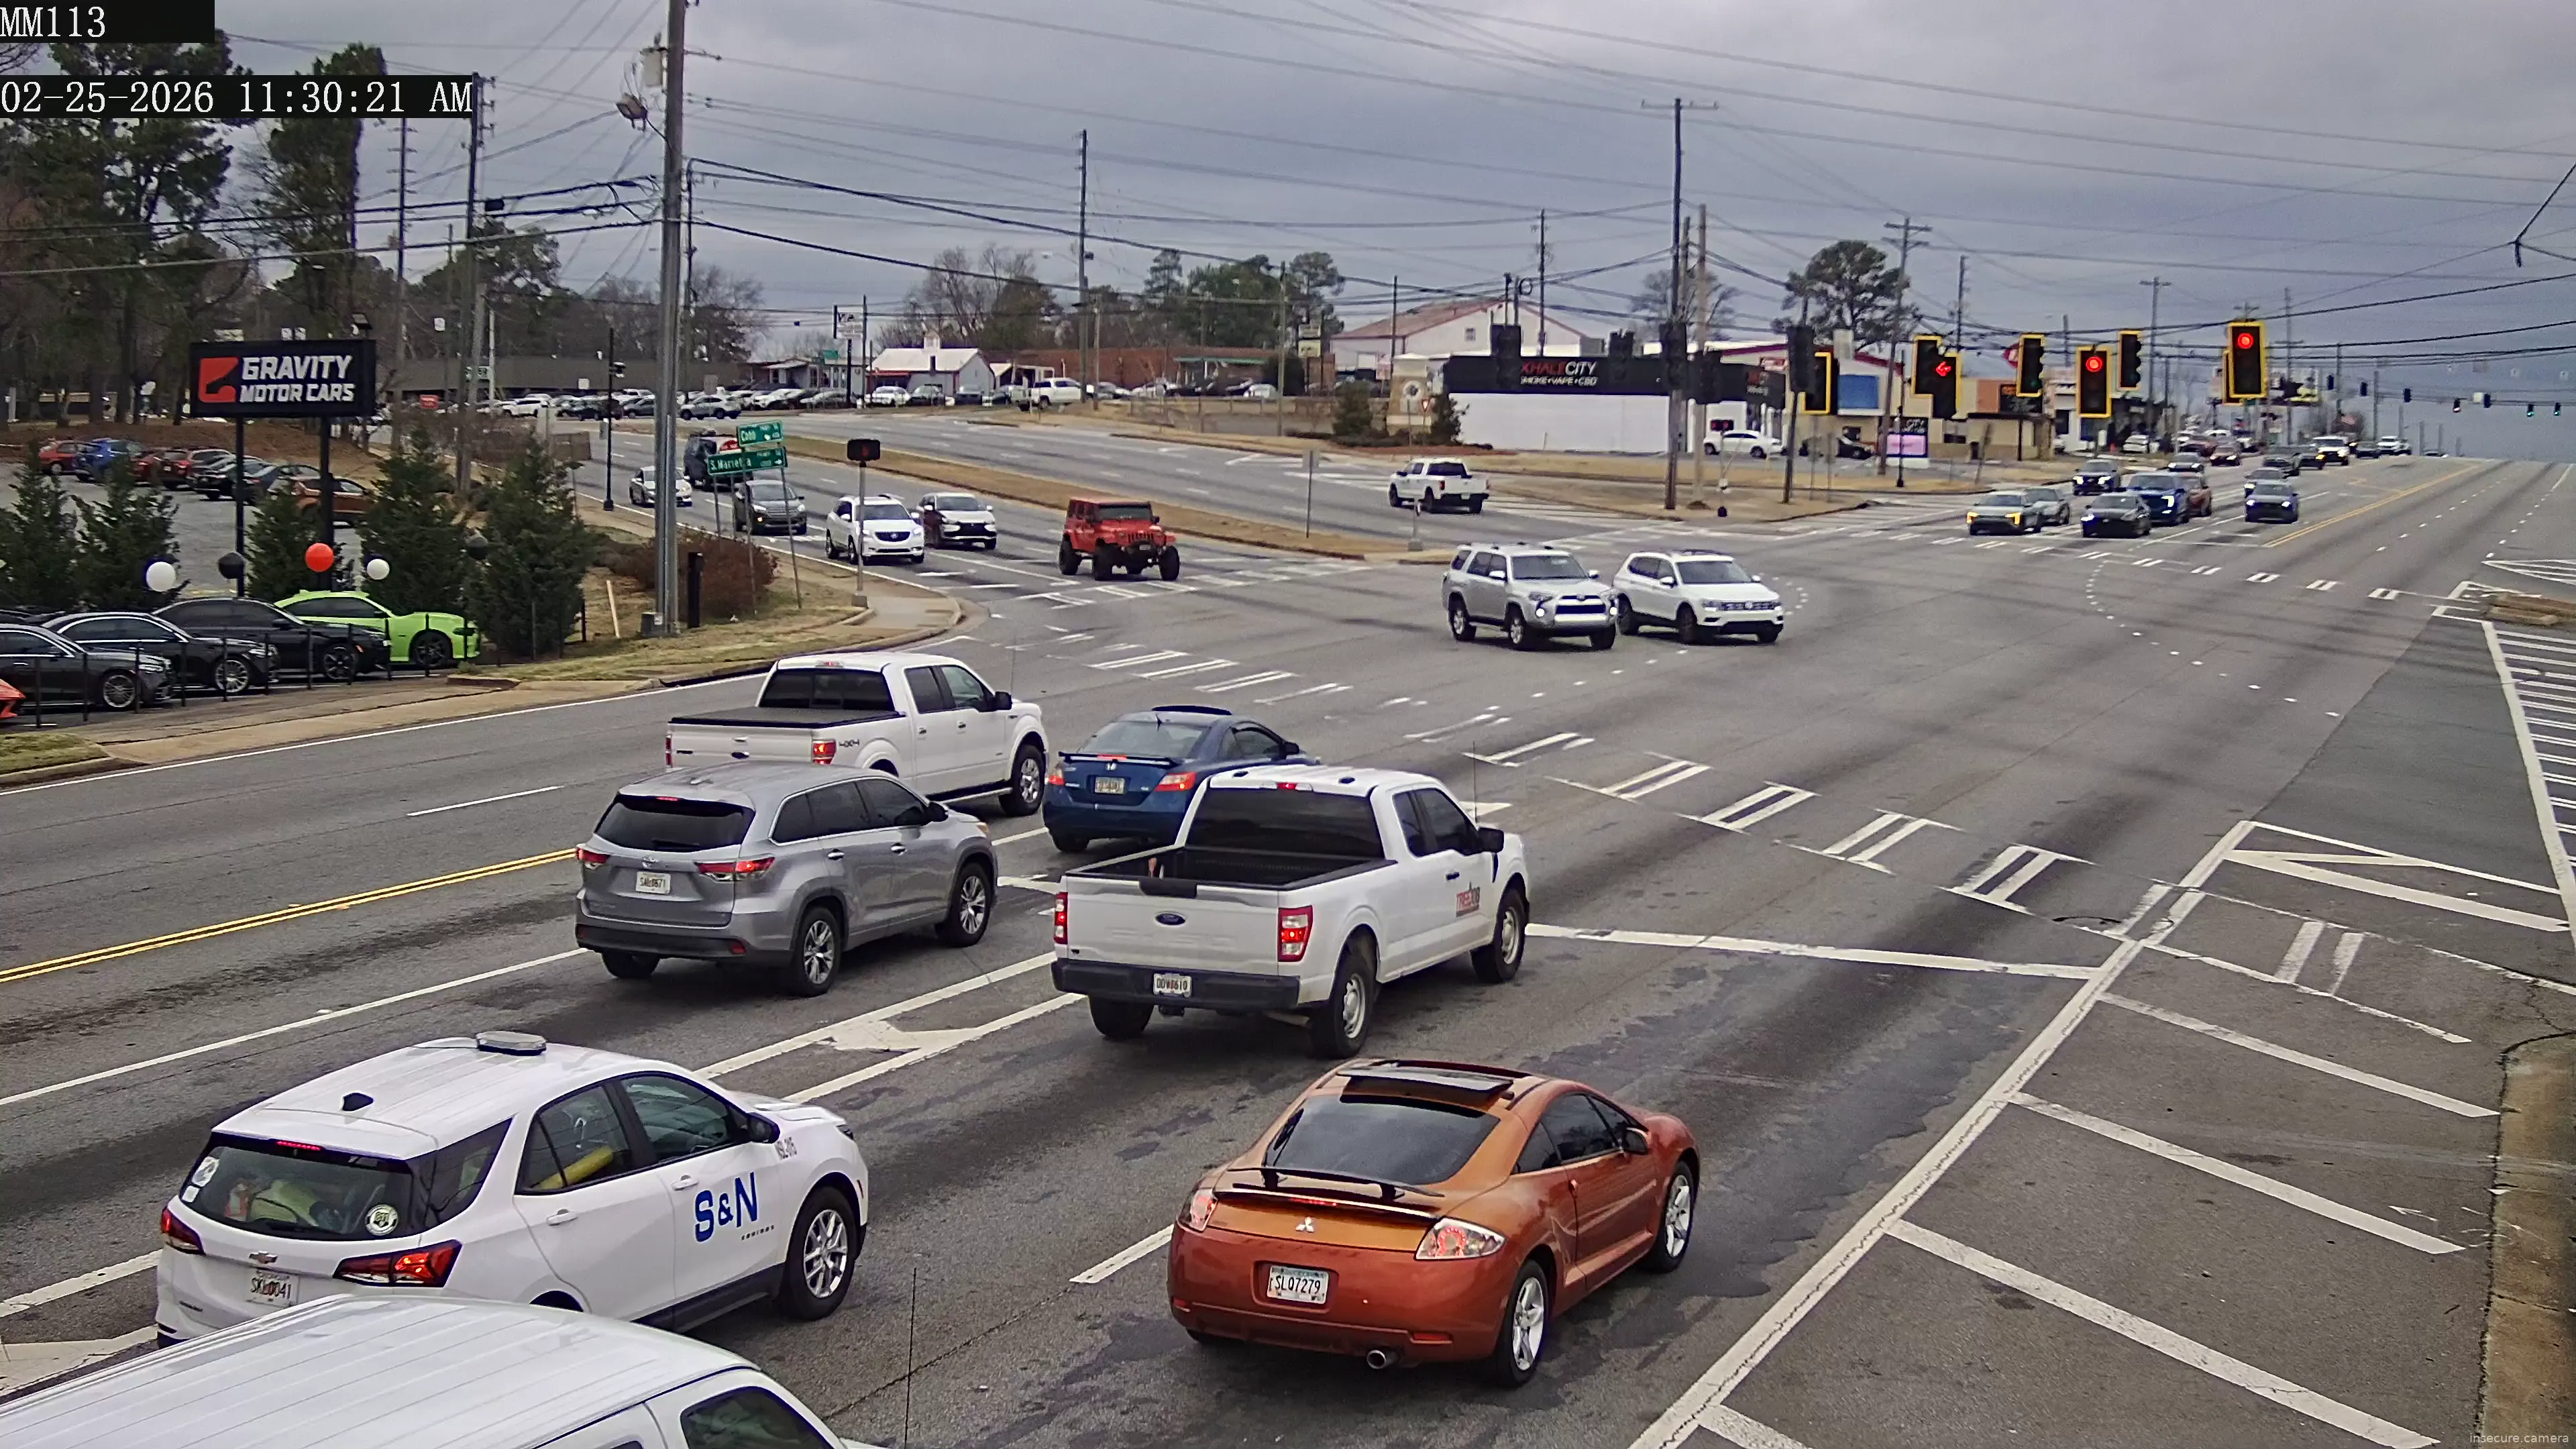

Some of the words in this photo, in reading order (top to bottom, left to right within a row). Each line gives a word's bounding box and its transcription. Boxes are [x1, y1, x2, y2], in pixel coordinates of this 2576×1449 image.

[241, 355, 353, 380] GRAVITY
[239, 383, 302, 402] MOTOR
[306, 383, 356, 402] CARS
[695, 1171, 758, 1242] S&N
